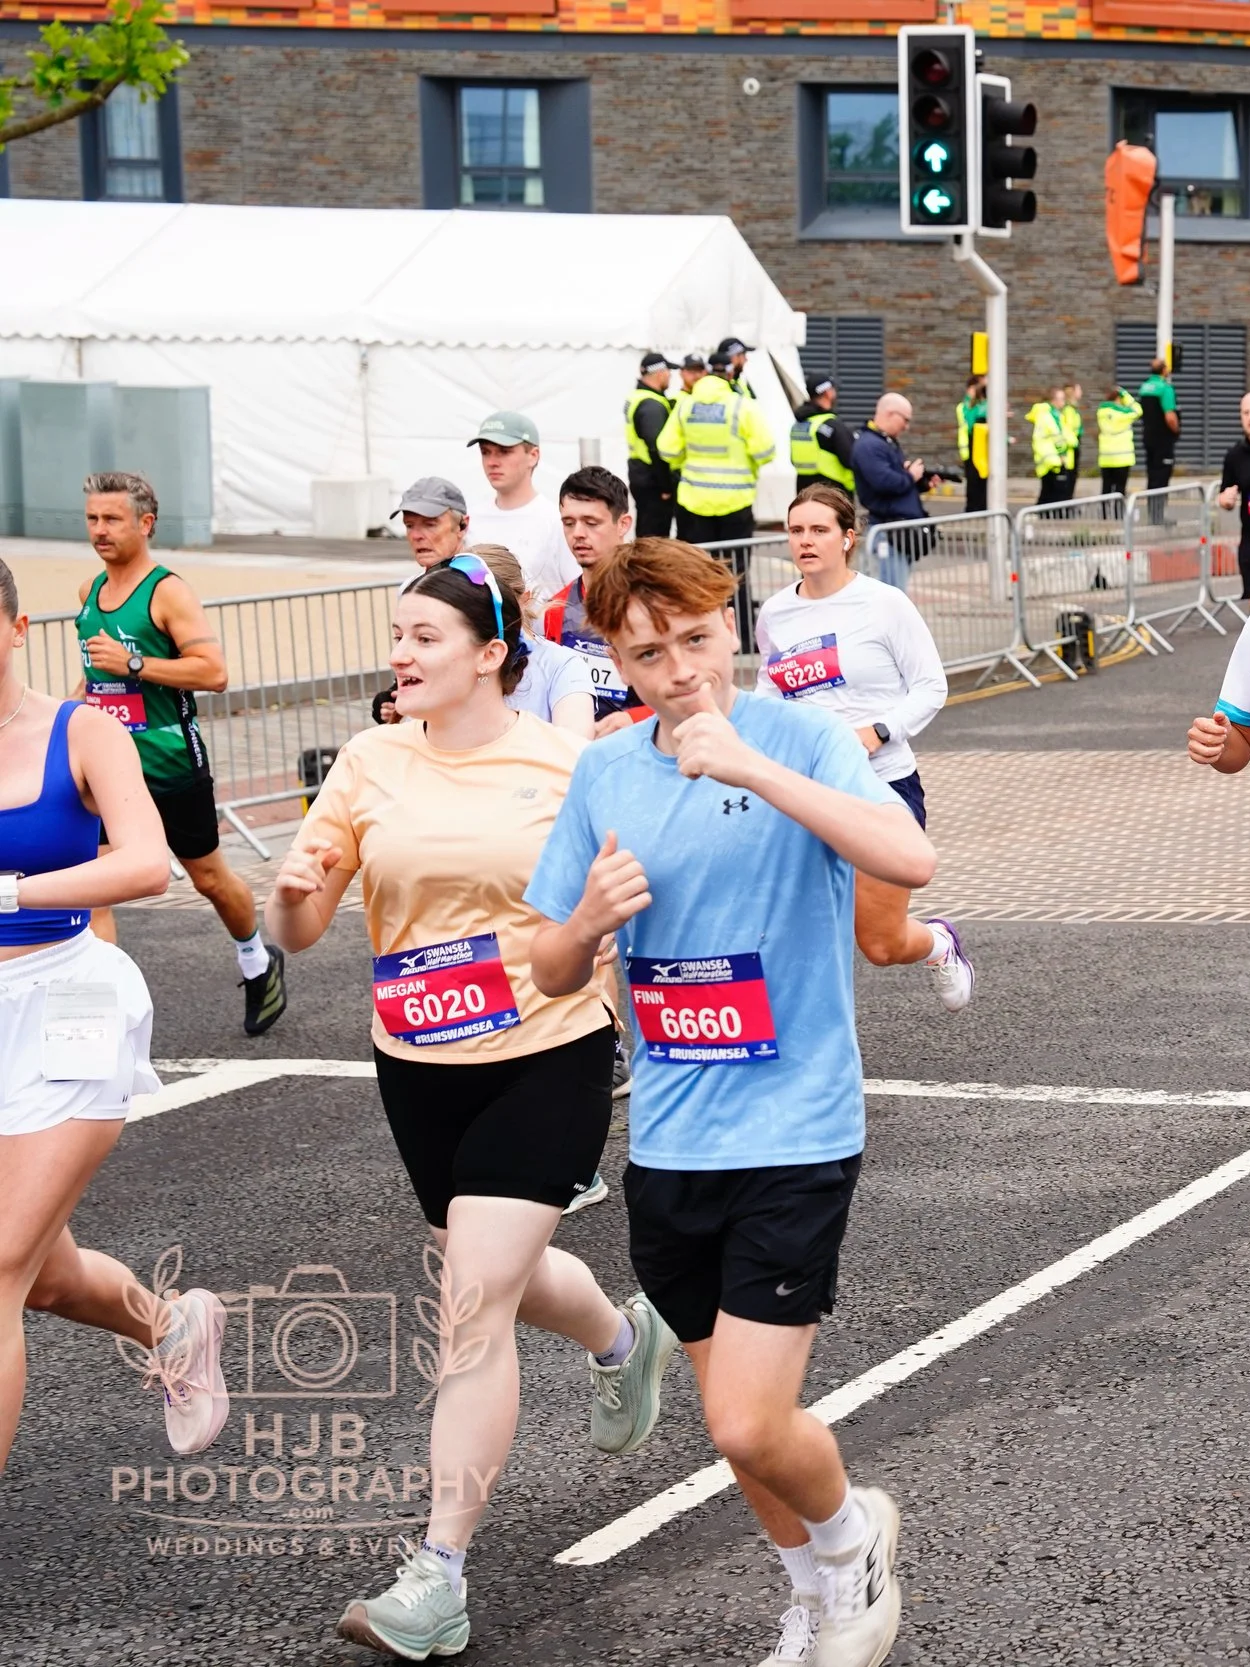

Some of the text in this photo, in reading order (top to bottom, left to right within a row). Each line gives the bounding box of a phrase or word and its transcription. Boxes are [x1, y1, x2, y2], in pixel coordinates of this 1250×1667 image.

[768, 660, 800, 676] RACHEL
[784, 660, 826, 688] 6228
[426, 941, 471, 959] SWANSEA
[681, 958, 731, 972] SWANSEA
[376, 980, 426, 1000] MEGAN
[634, 990, 665, 1004] FINN
[404, 984, 486, 1026] 6020
[415, 1020, 494, 1044] #RUNSWANSEA
[660, 1006, 742, 1040] 6660
[669, 1048, 750, 1060] #RUNSWANSEA
